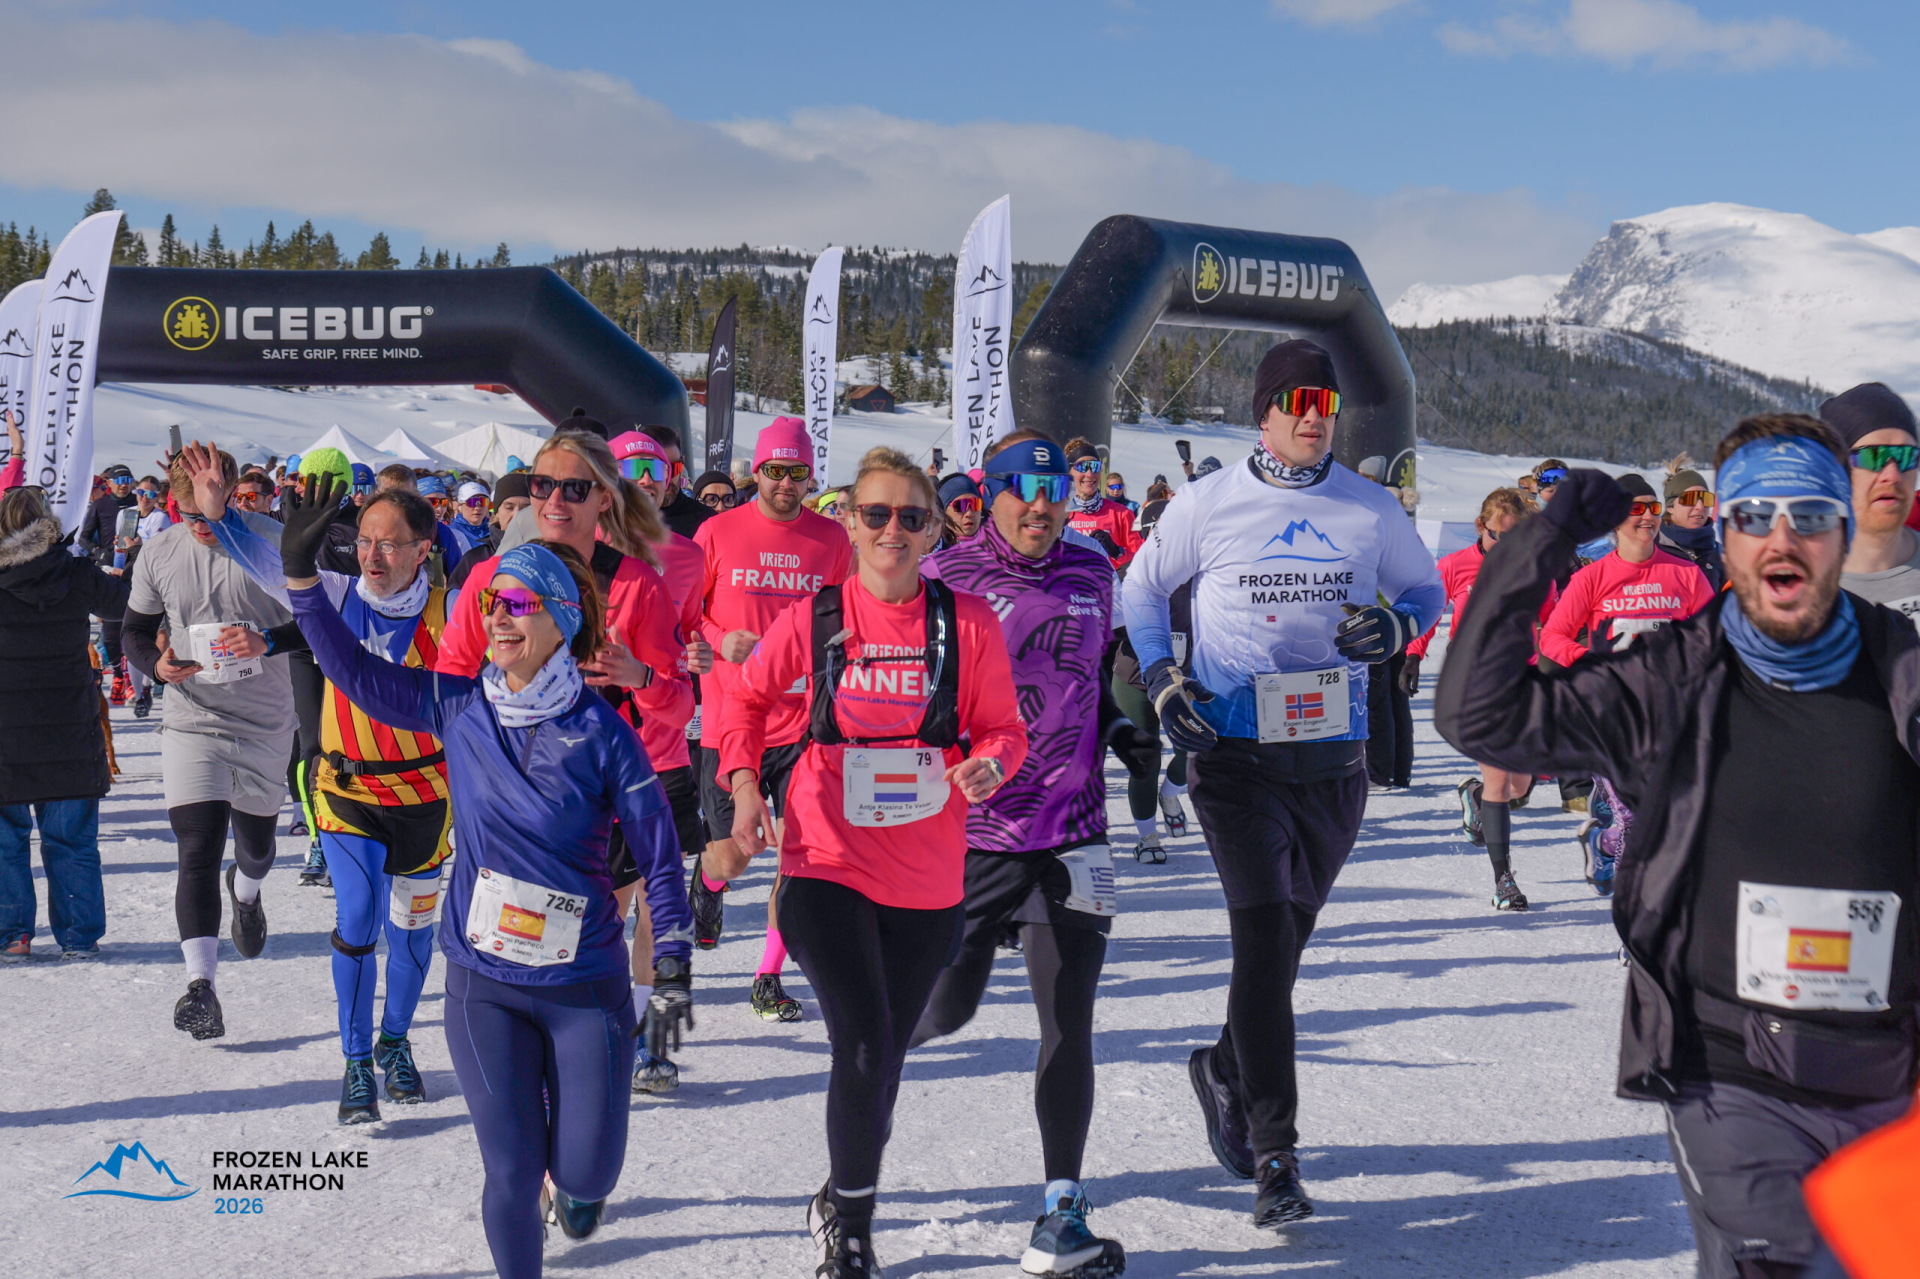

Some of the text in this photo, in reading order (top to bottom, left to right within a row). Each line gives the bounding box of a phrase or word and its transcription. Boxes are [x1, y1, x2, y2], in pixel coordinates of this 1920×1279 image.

[262, 348, 298, 359] SAFE
[342, 348, 378, 359] FREE
[383, 347, 423, 359] MIND.
[968, 394, 984, 467] OZEN
[731, 568, 824, 593] FRANKE
[1239, 571, 1354, 588] FROZEN LAKE
[1251, 588, 1348, 605] MARATHON
[1602, 596, 1681, 612] SUZANNA
[1067, 605, 1091, 616] Give
[238, 667, 253, 678] 750
[1317, 671, 1340, 686] 728
[840, 691, 866, 702] Frozen
[867, 696, 886, 705] Lake
[916, 751, 932, 766] 79
[859, 803, 876, 811] Antje
[546, 893, 575, 913] 726
[514, 938, 545, 950] Pacheco
